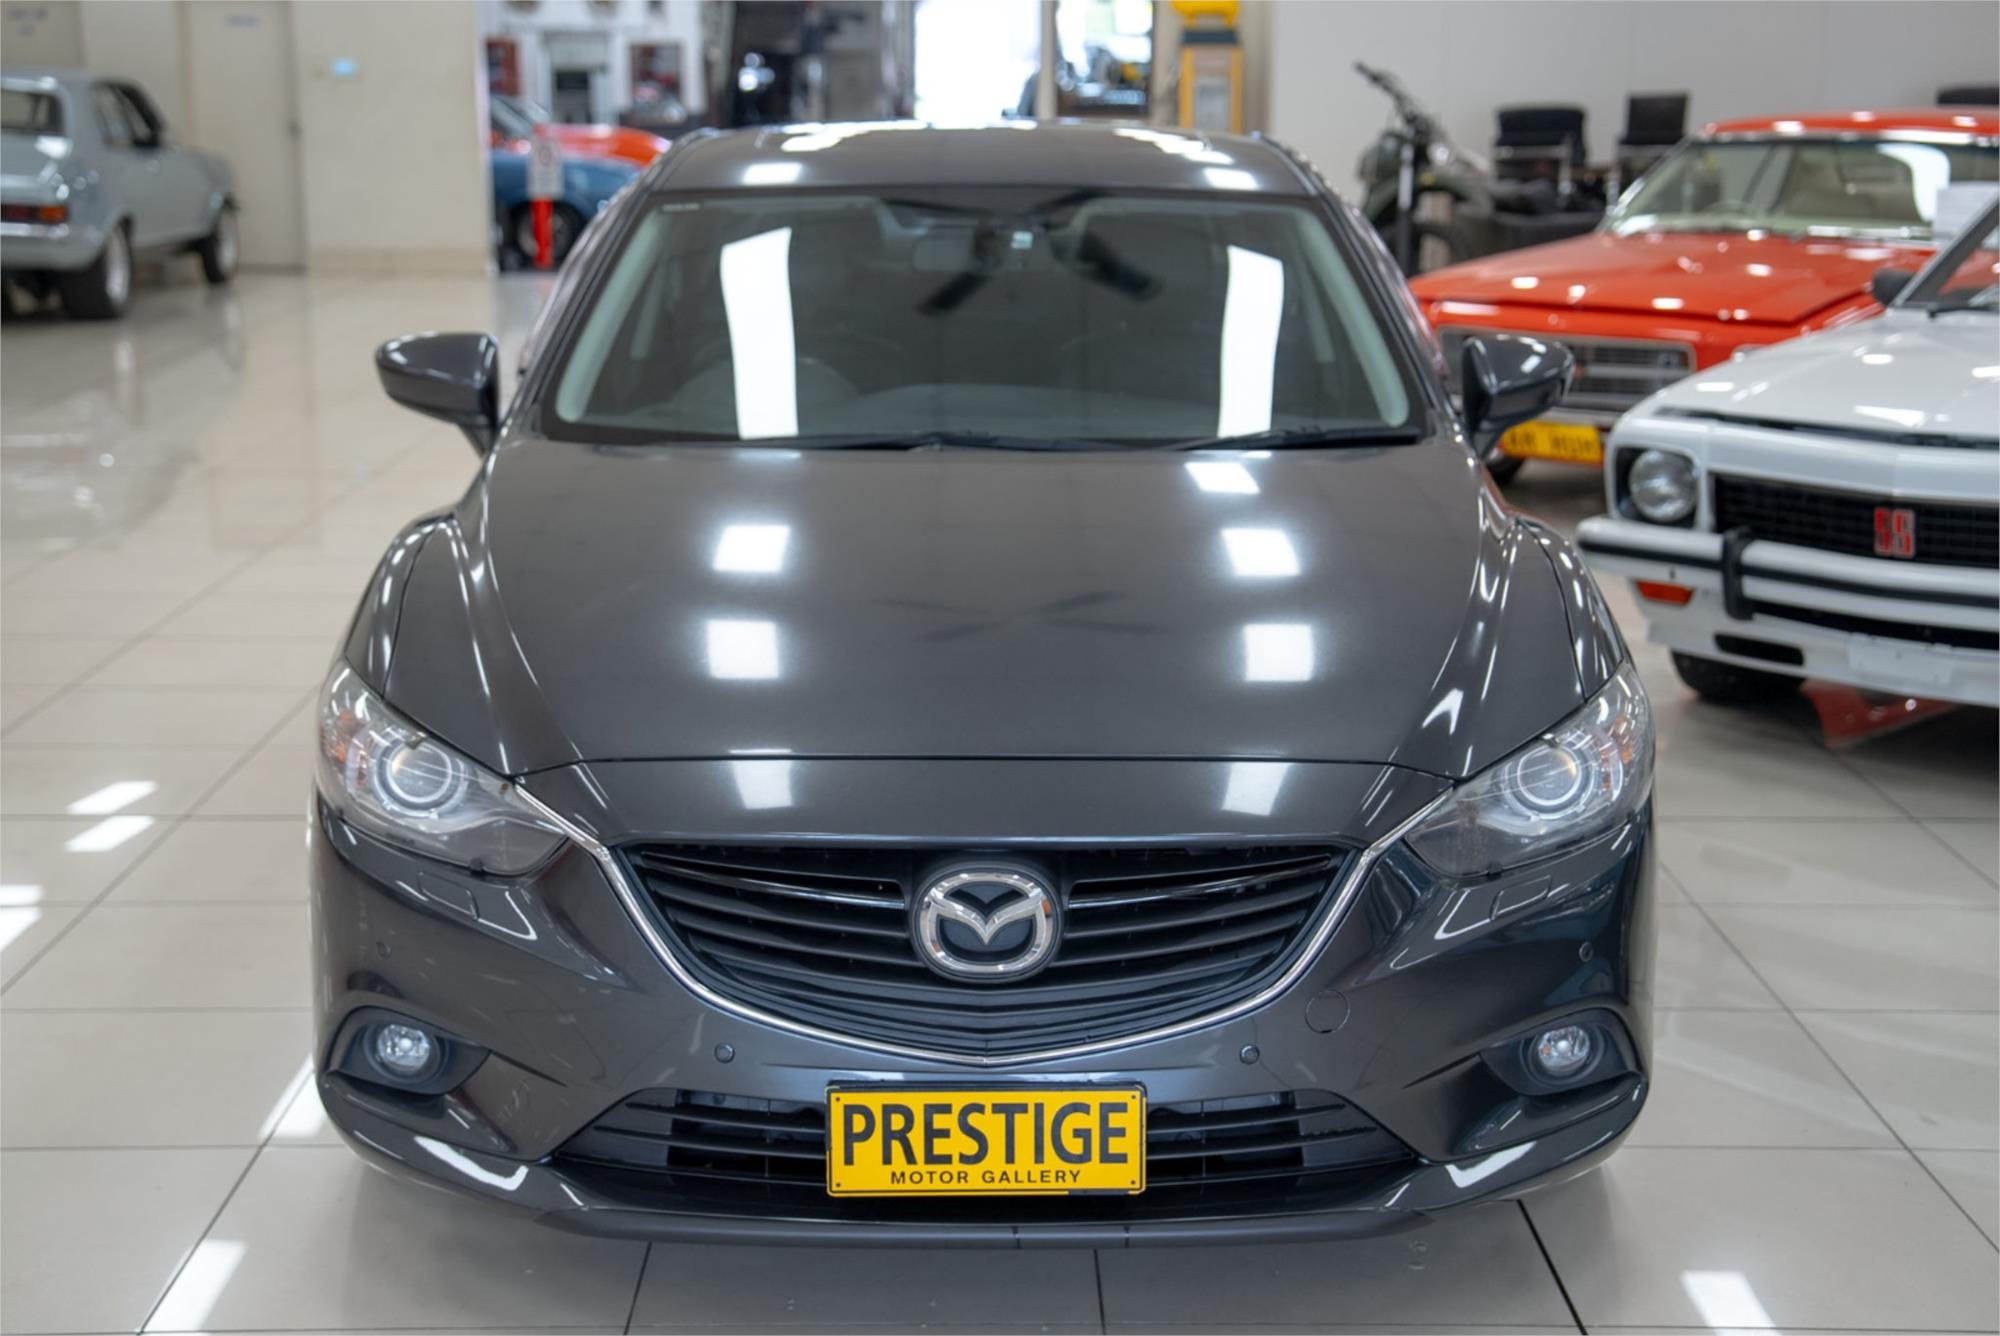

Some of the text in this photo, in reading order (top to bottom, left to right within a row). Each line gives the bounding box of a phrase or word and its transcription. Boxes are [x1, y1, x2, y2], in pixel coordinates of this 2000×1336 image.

[843, 1102, 1128, 1166] PRESTIGE
[891, 1170, 1081, 1184] MOTOR GALLERY
